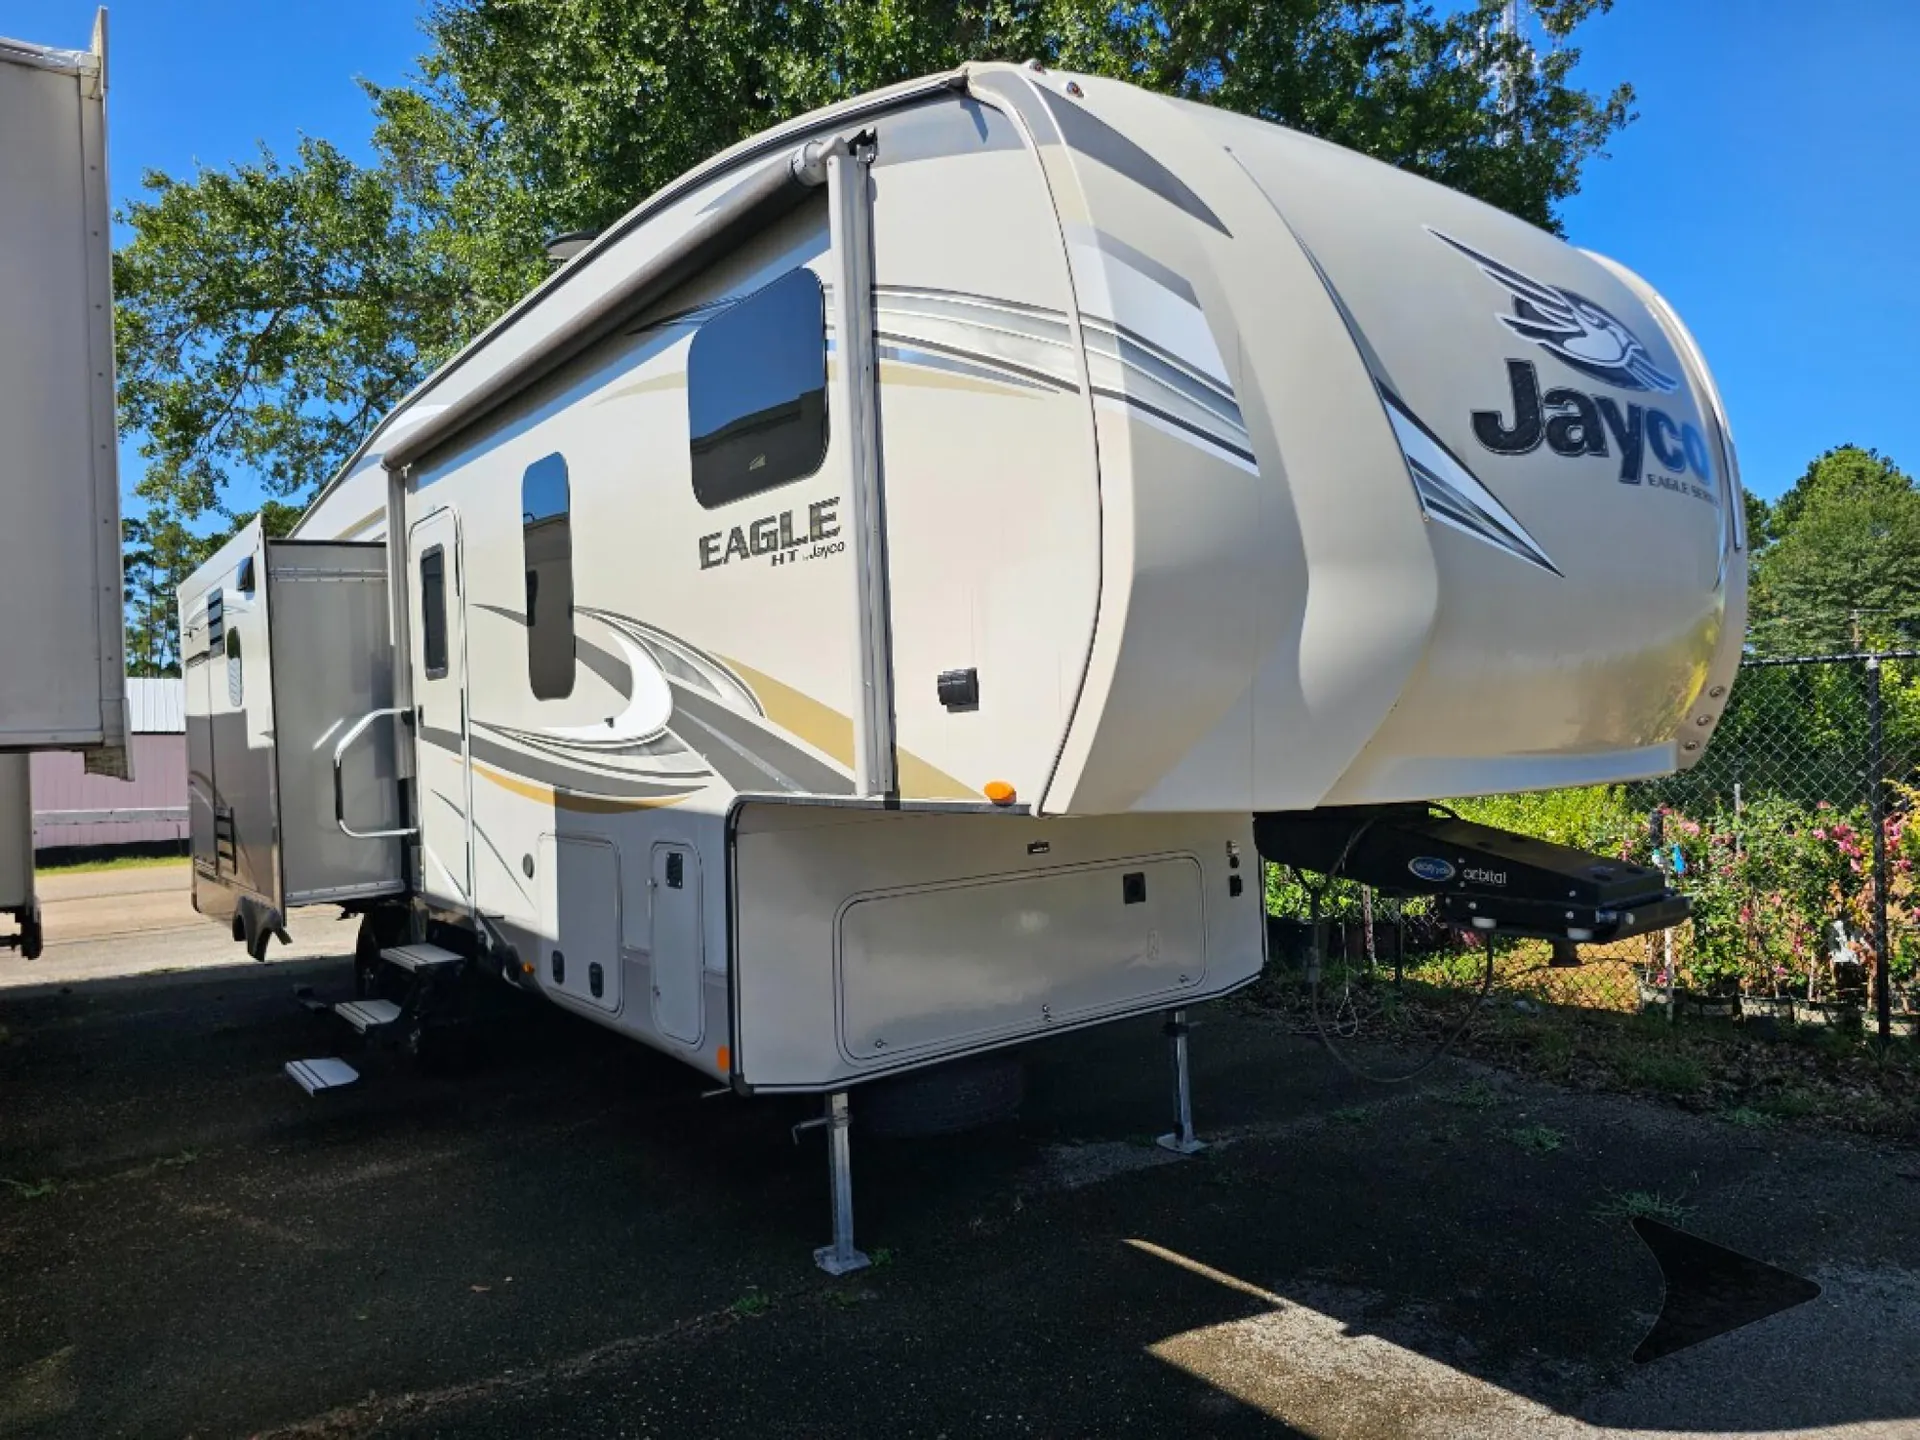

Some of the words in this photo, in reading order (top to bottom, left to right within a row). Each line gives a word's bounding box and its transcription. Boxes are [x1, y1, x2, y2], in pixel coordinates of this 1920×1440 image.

[1470, 358, 1711, 486] Jayco
[1646, 473, 1690, 496] EAGLE
[699, 496, 841, 570] EAGLE
[771, 549, 799, 566] HT
[810, 541, 845, 559] Jayco
[1462, 867, 1507, 884] orbital
